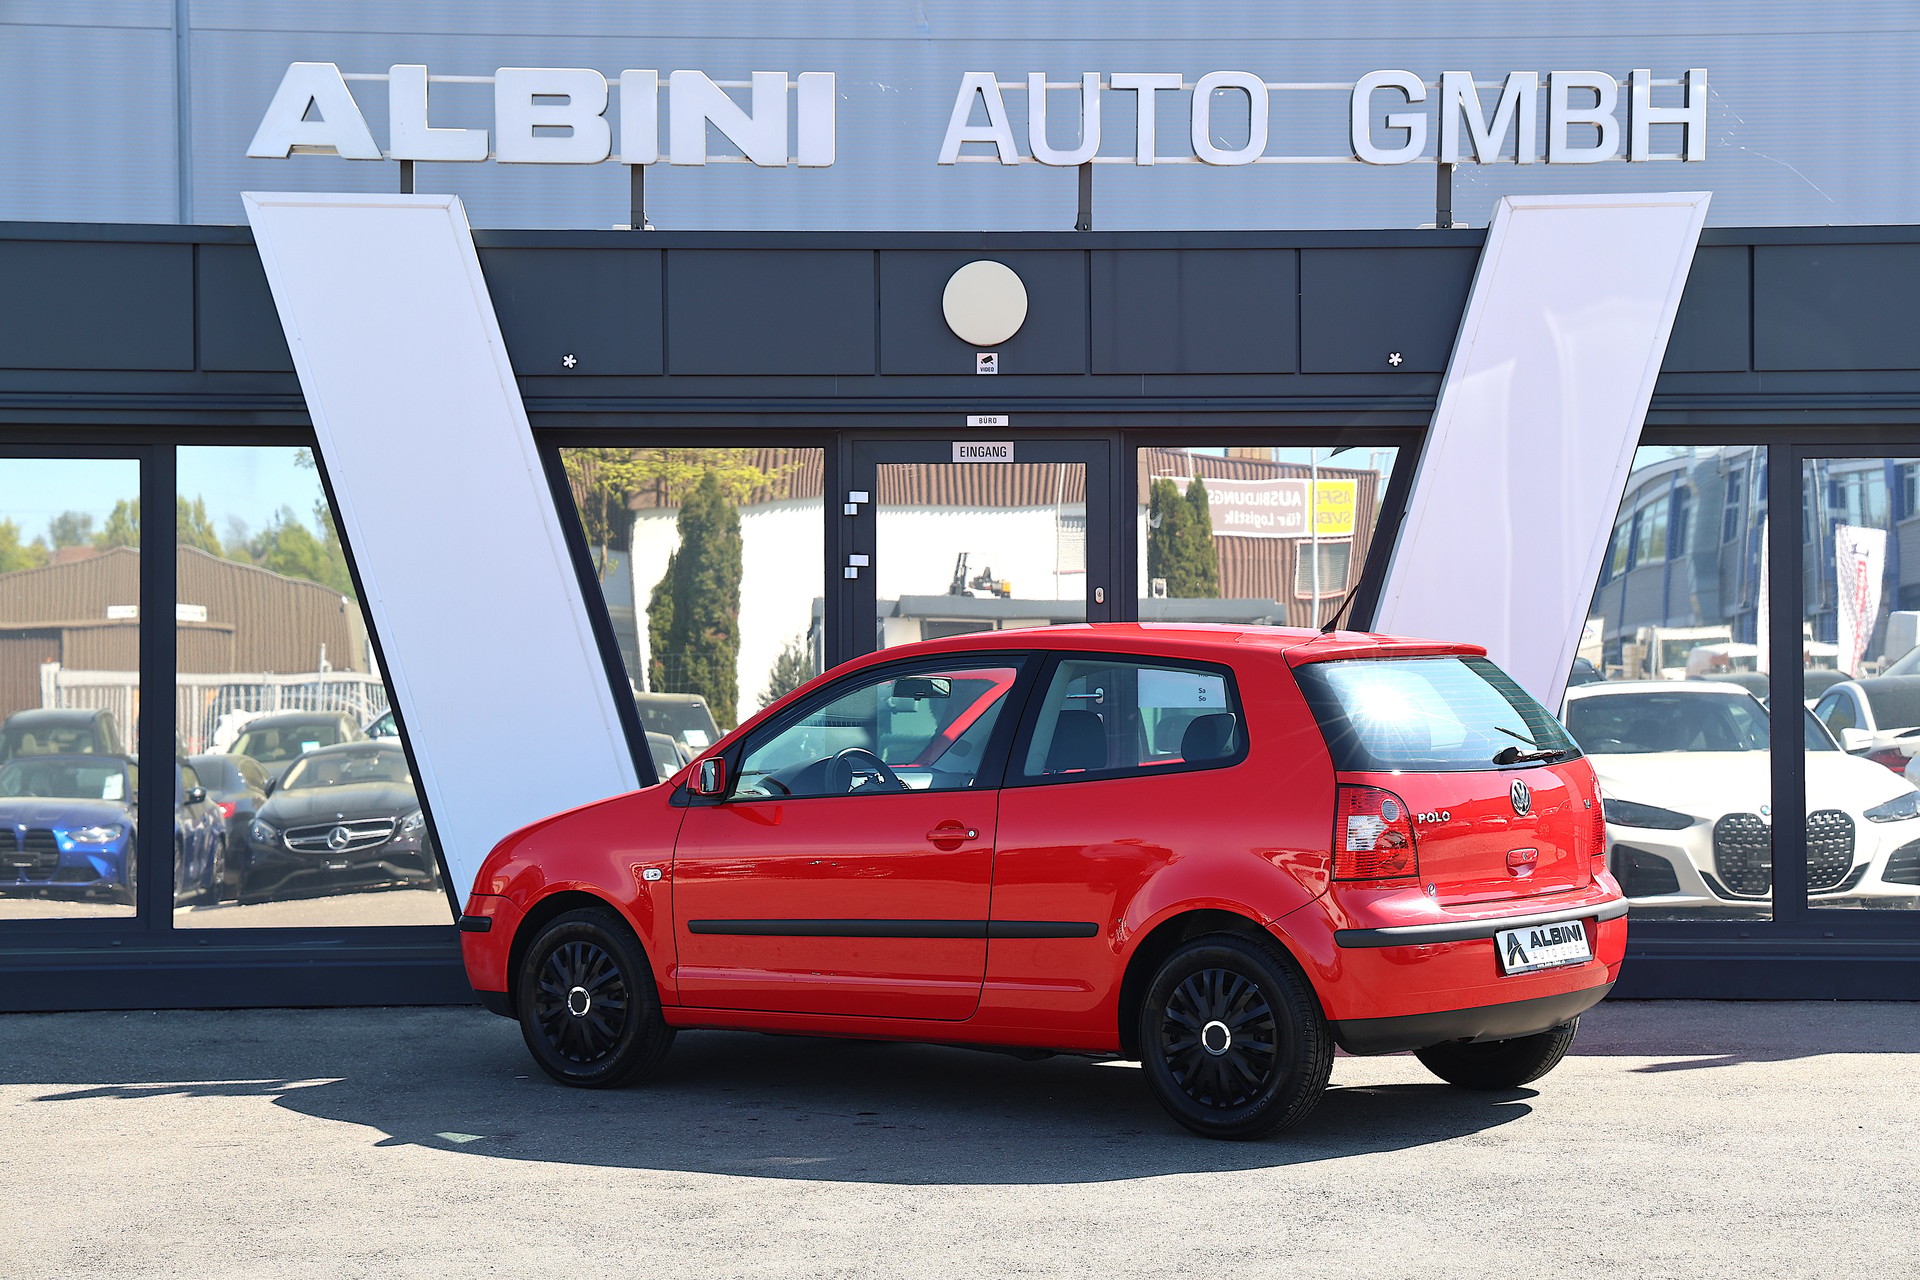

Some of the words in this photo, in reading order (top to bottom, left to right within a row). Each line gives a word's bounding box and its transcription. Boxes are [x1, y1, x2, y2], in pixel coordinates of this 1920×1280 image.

[245, 61, 837, 168] ALBINI
[937, 69, 1270, 167] AUTO
[1349, 67, 1708, 165] GMBH
[960, 446, 1007, 458] EINGANG
[1417, 811, 1451, 824] POLO
[1530, 924, 1583, 949] ALBINI
